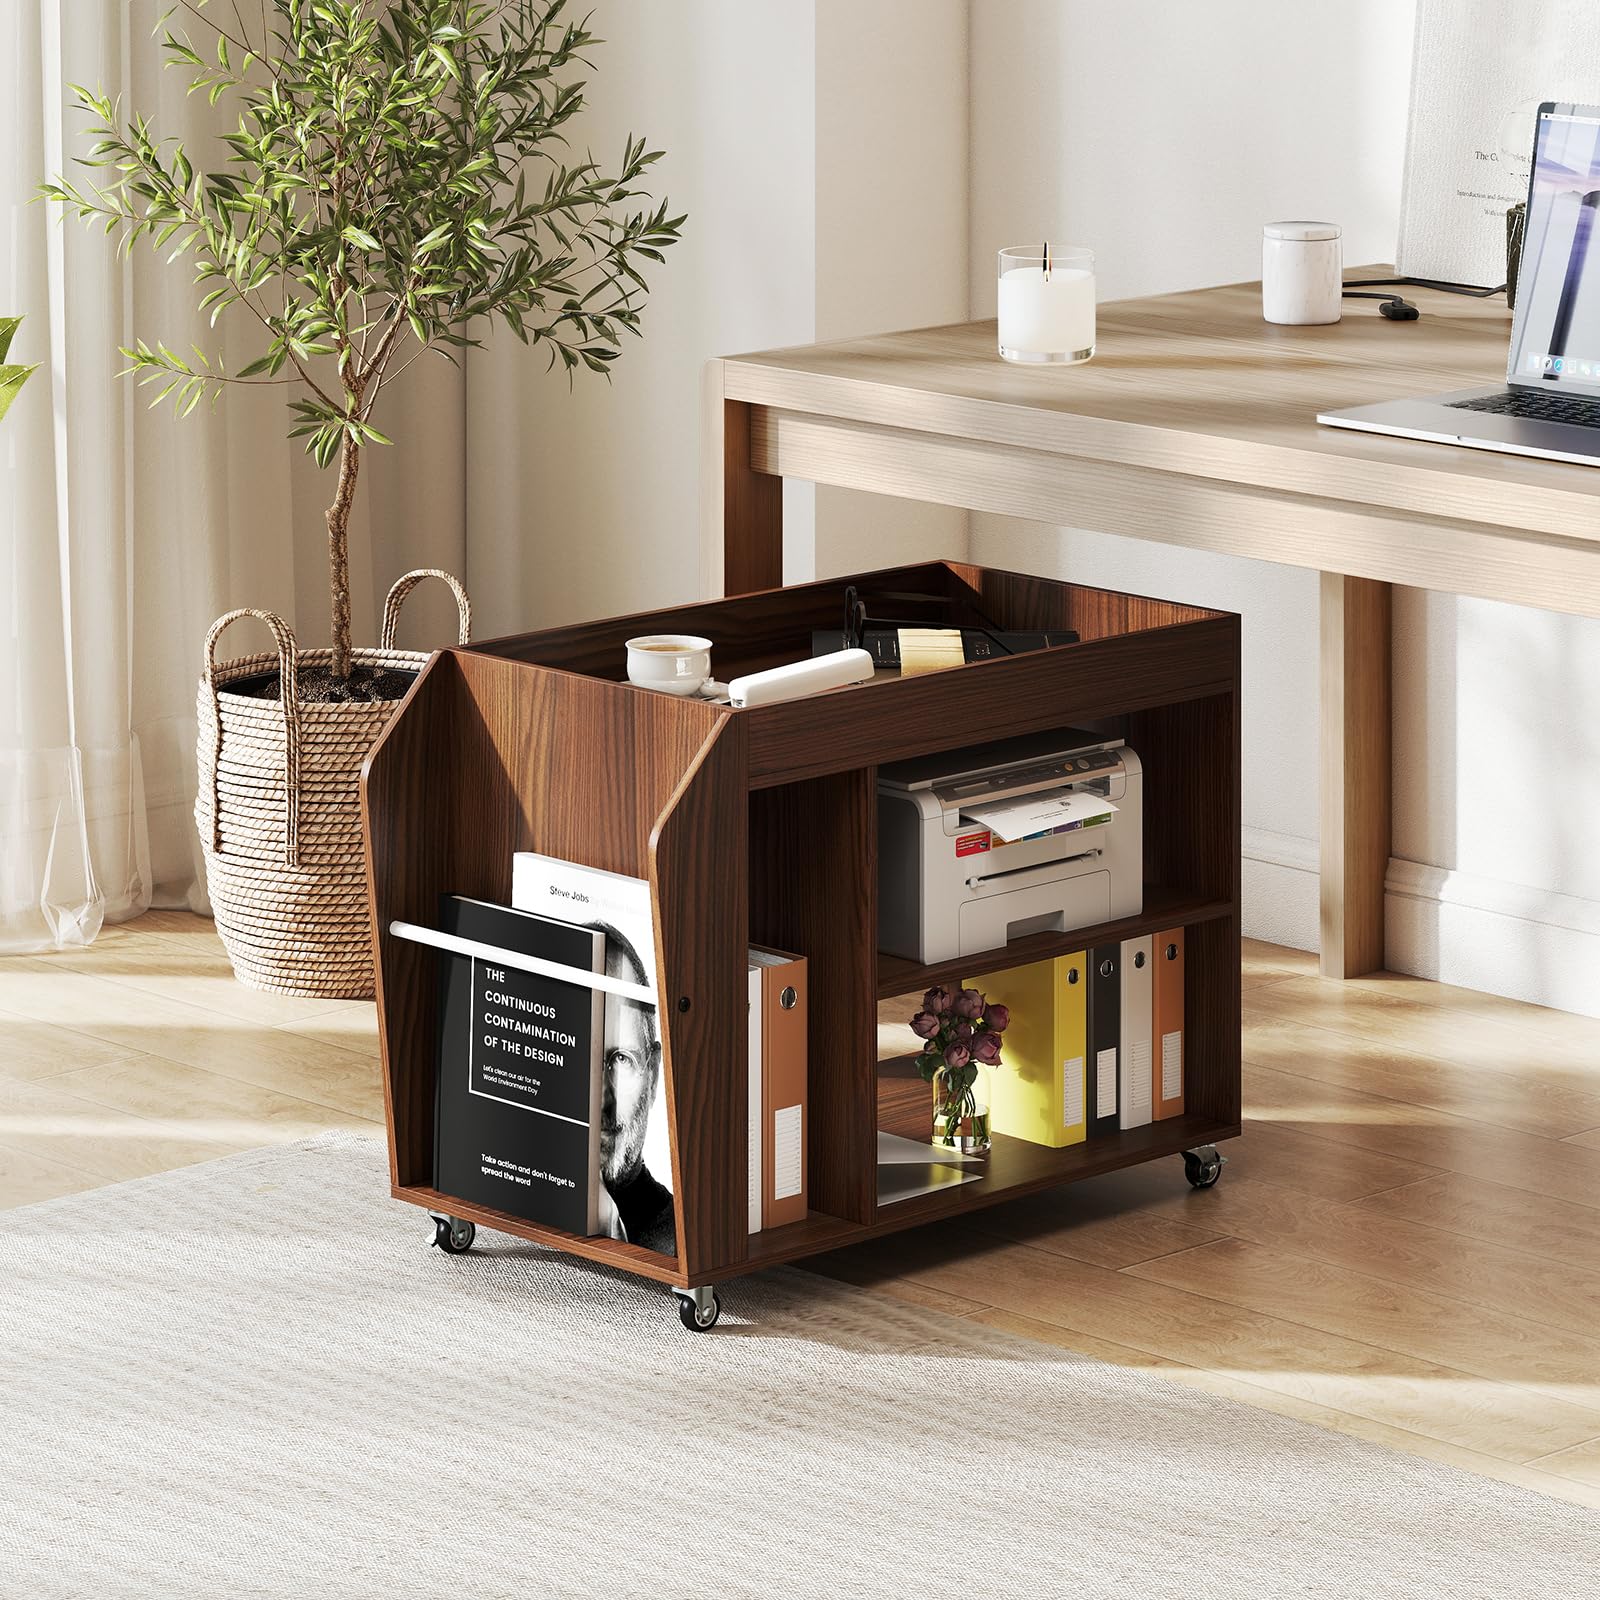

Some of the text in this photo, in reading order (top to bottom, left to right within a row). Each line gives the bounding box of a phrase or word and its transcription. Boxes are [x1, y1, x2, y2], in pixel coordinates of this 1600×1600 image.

[1475, 151, 1489, 161] The
[549, 885, 590, 904] Steve Jobs
[485, 967, 505, 983] THE
[485, 990, 556, 1019] CONTINUOUS
[484, 1012, 576, 1048] CONTAMINATION
[484, 1035, 564, 1067] OF THE DESIGN
[483, 1073, 538, 1096] World Environment Day
[494, 1067, 508, 1077] clean
[517, 1074, 525, 1082] air
[532, 1079, 541, 1087] the
[481, 1153, 576, 1188] Take action and don't forget to
[481, 1166, 531, 1187] spread the word
